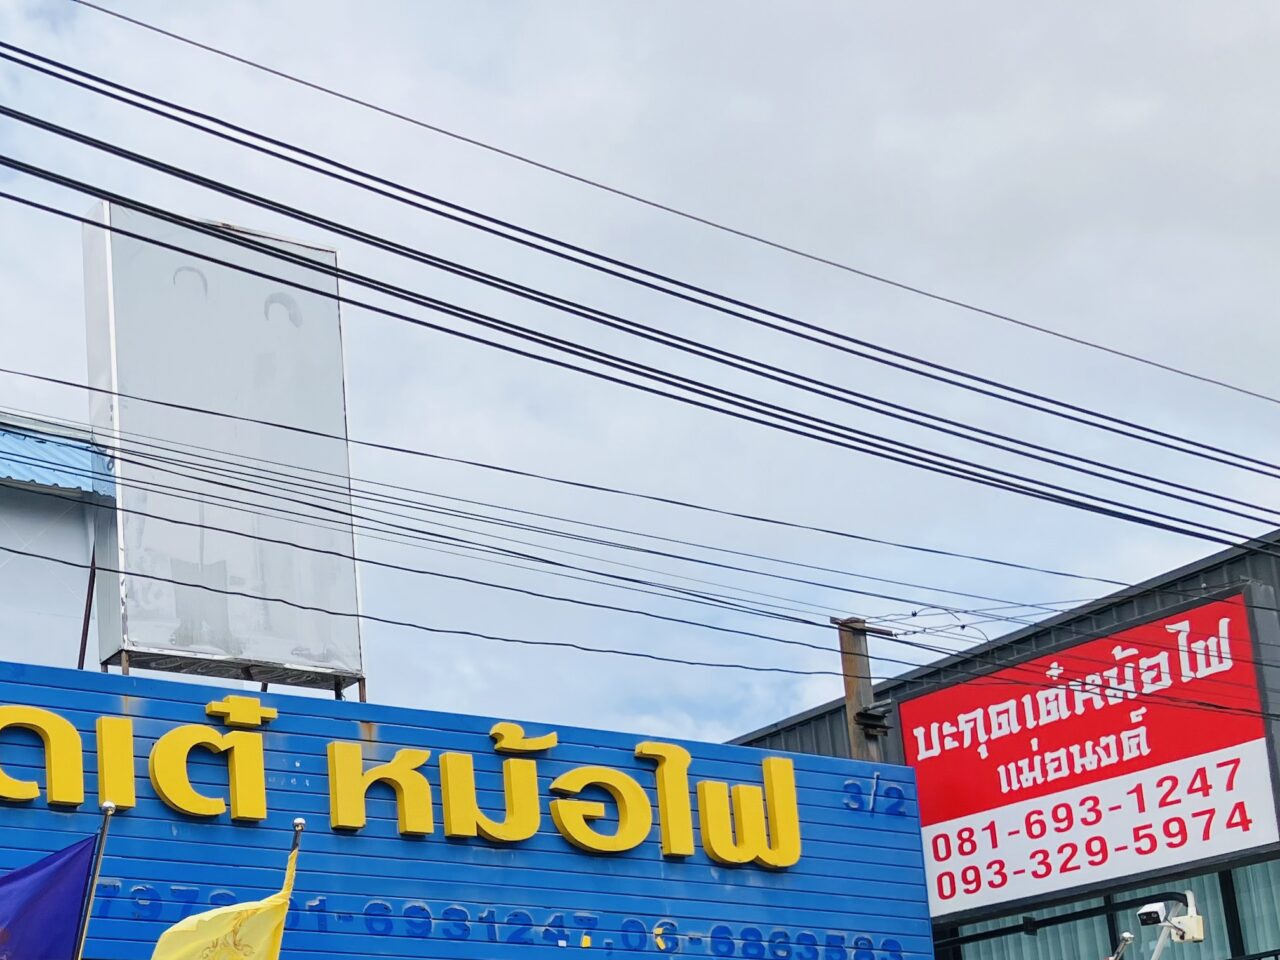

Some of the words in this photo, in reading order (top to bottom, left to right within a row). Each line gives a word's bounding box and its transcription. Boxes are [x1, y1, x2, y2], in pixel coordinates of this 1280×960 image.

[913, 617, 1233, 761] บะกุดเต๋หม้อไฟ
[326, 722, 802, 871] หม้อไฟ
[997, 707, 1152, 793] แม่อนงค์
[931, 757, 1242, 863] 081-693-1247
[936, 801, 1253, 901] 093-329-5974
